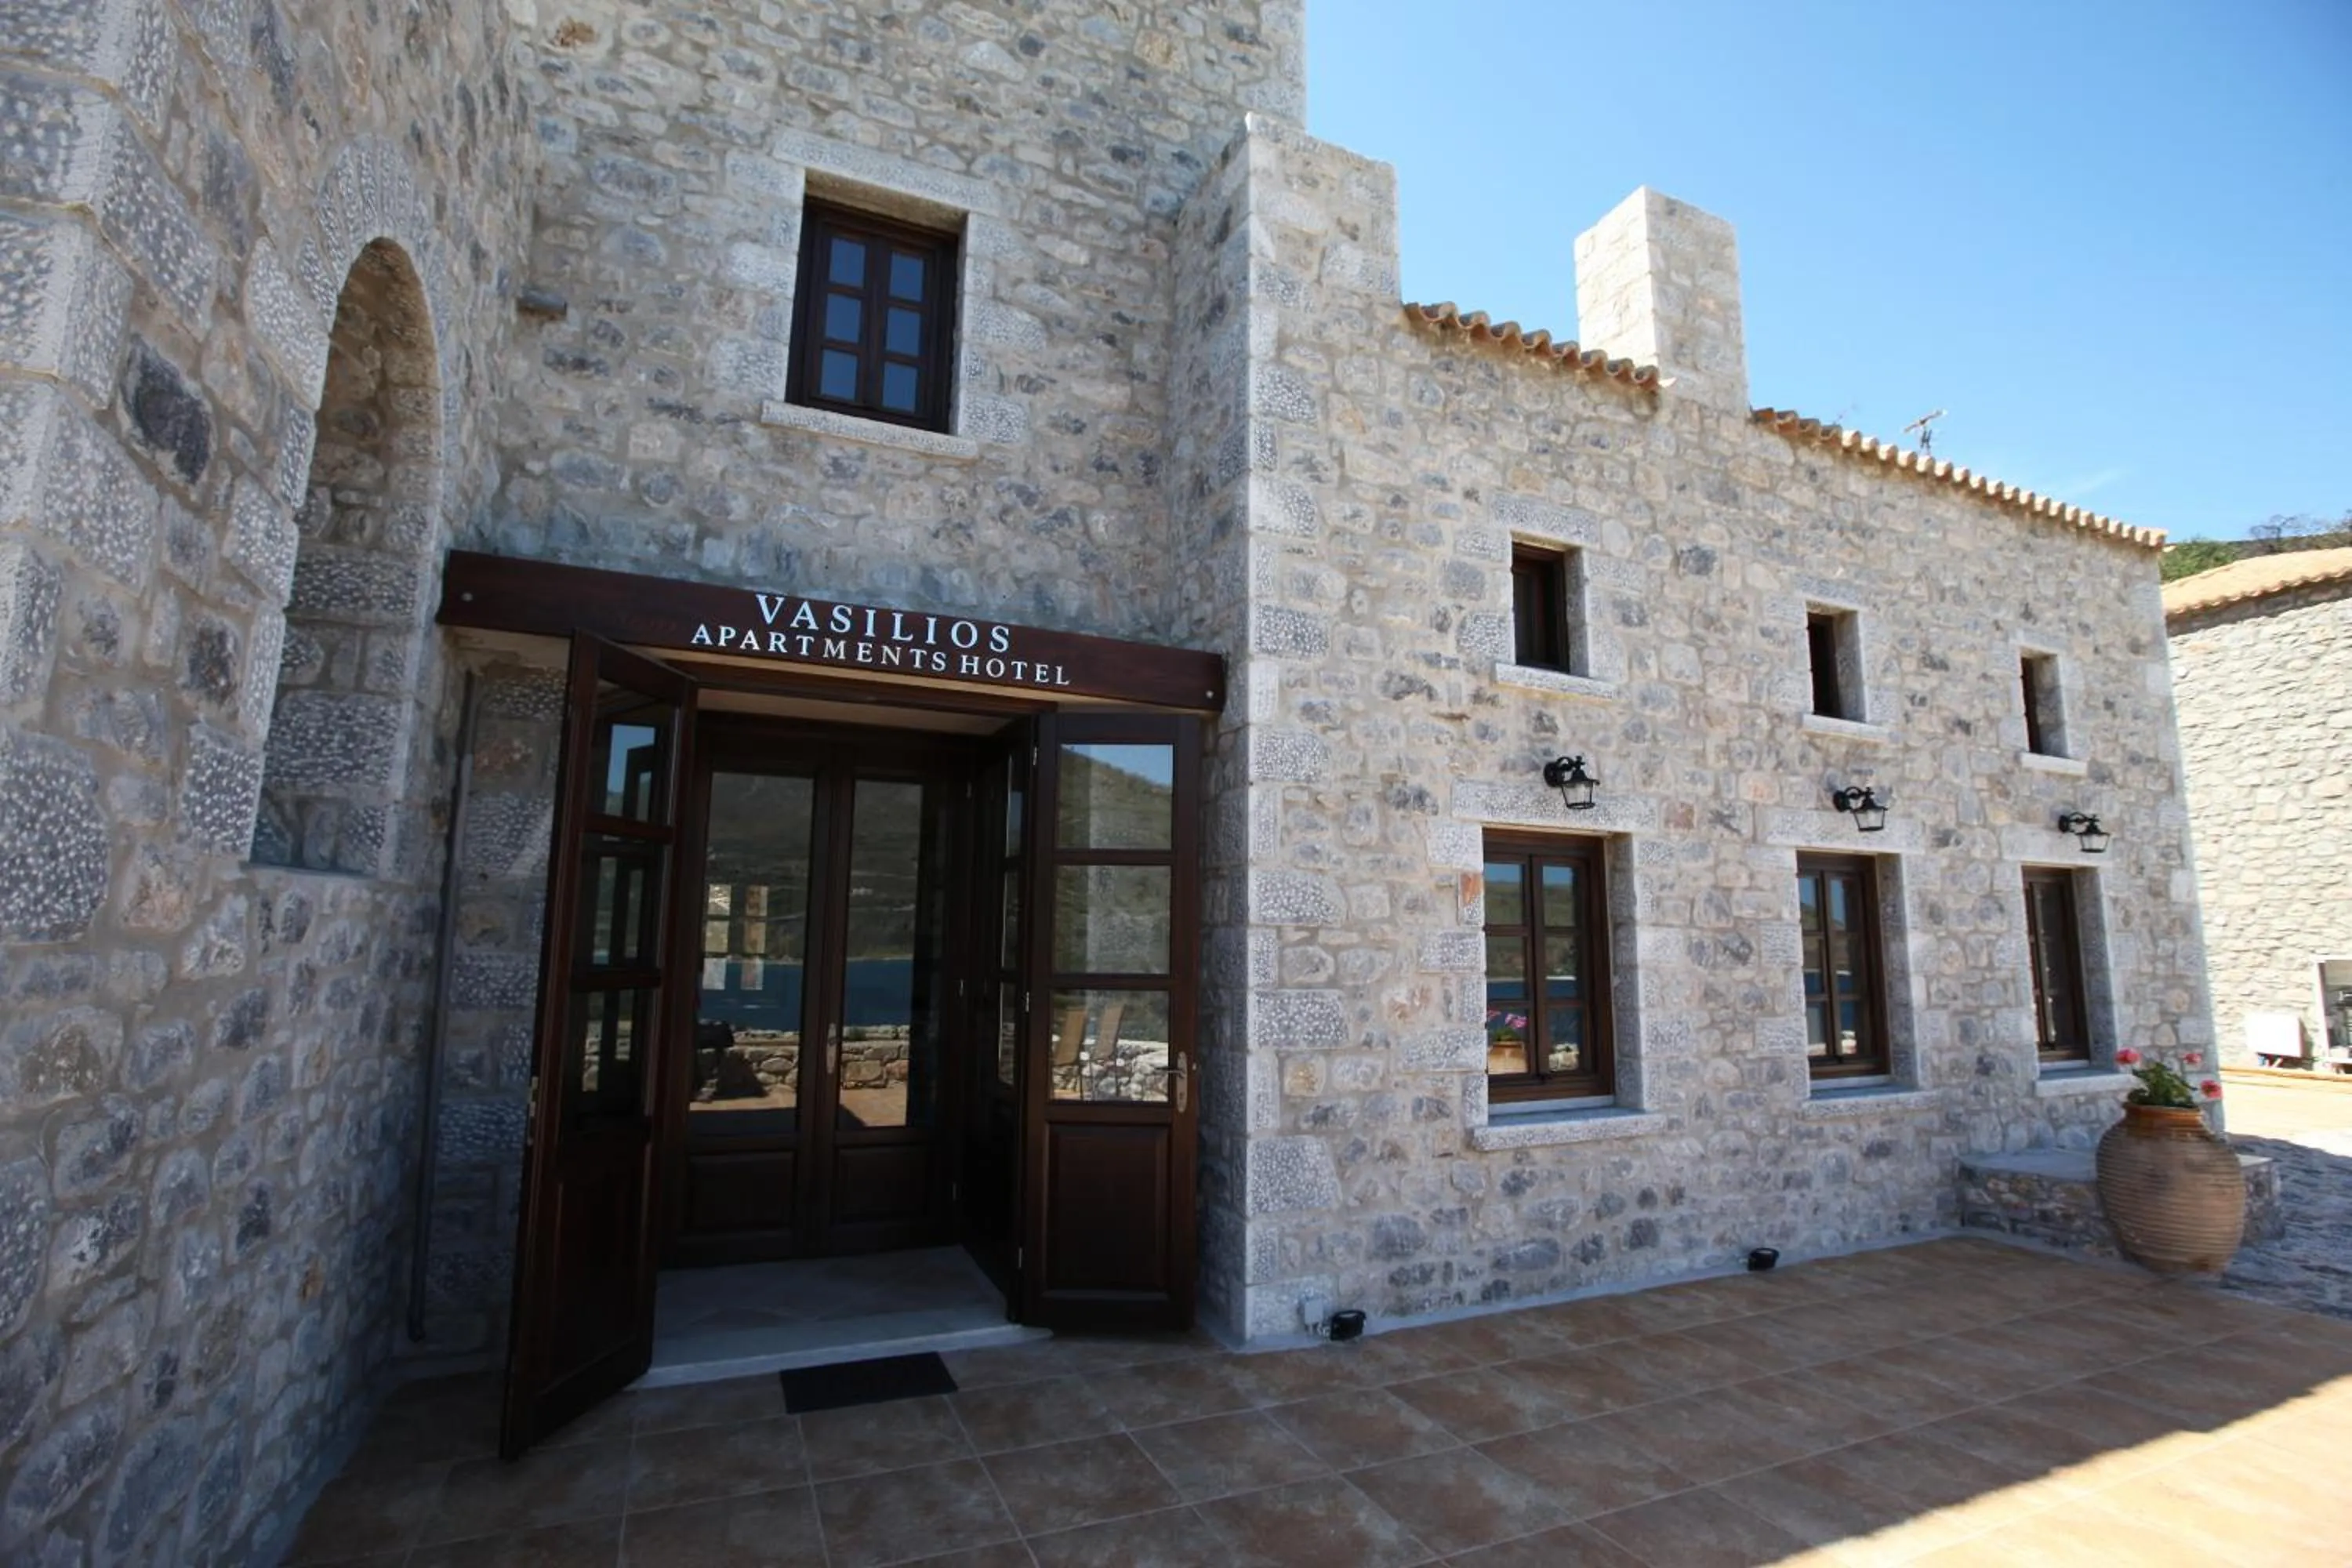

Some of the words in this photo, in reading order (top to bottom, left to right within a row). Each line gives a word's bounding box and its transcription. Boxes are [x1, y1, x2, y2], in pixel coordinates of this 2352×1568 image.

[756, 593, 1010, 653] VASILIOS
[691, 623, 946, 672] APARTMENTS
[960, 655, 1070, 686] HOTEL
